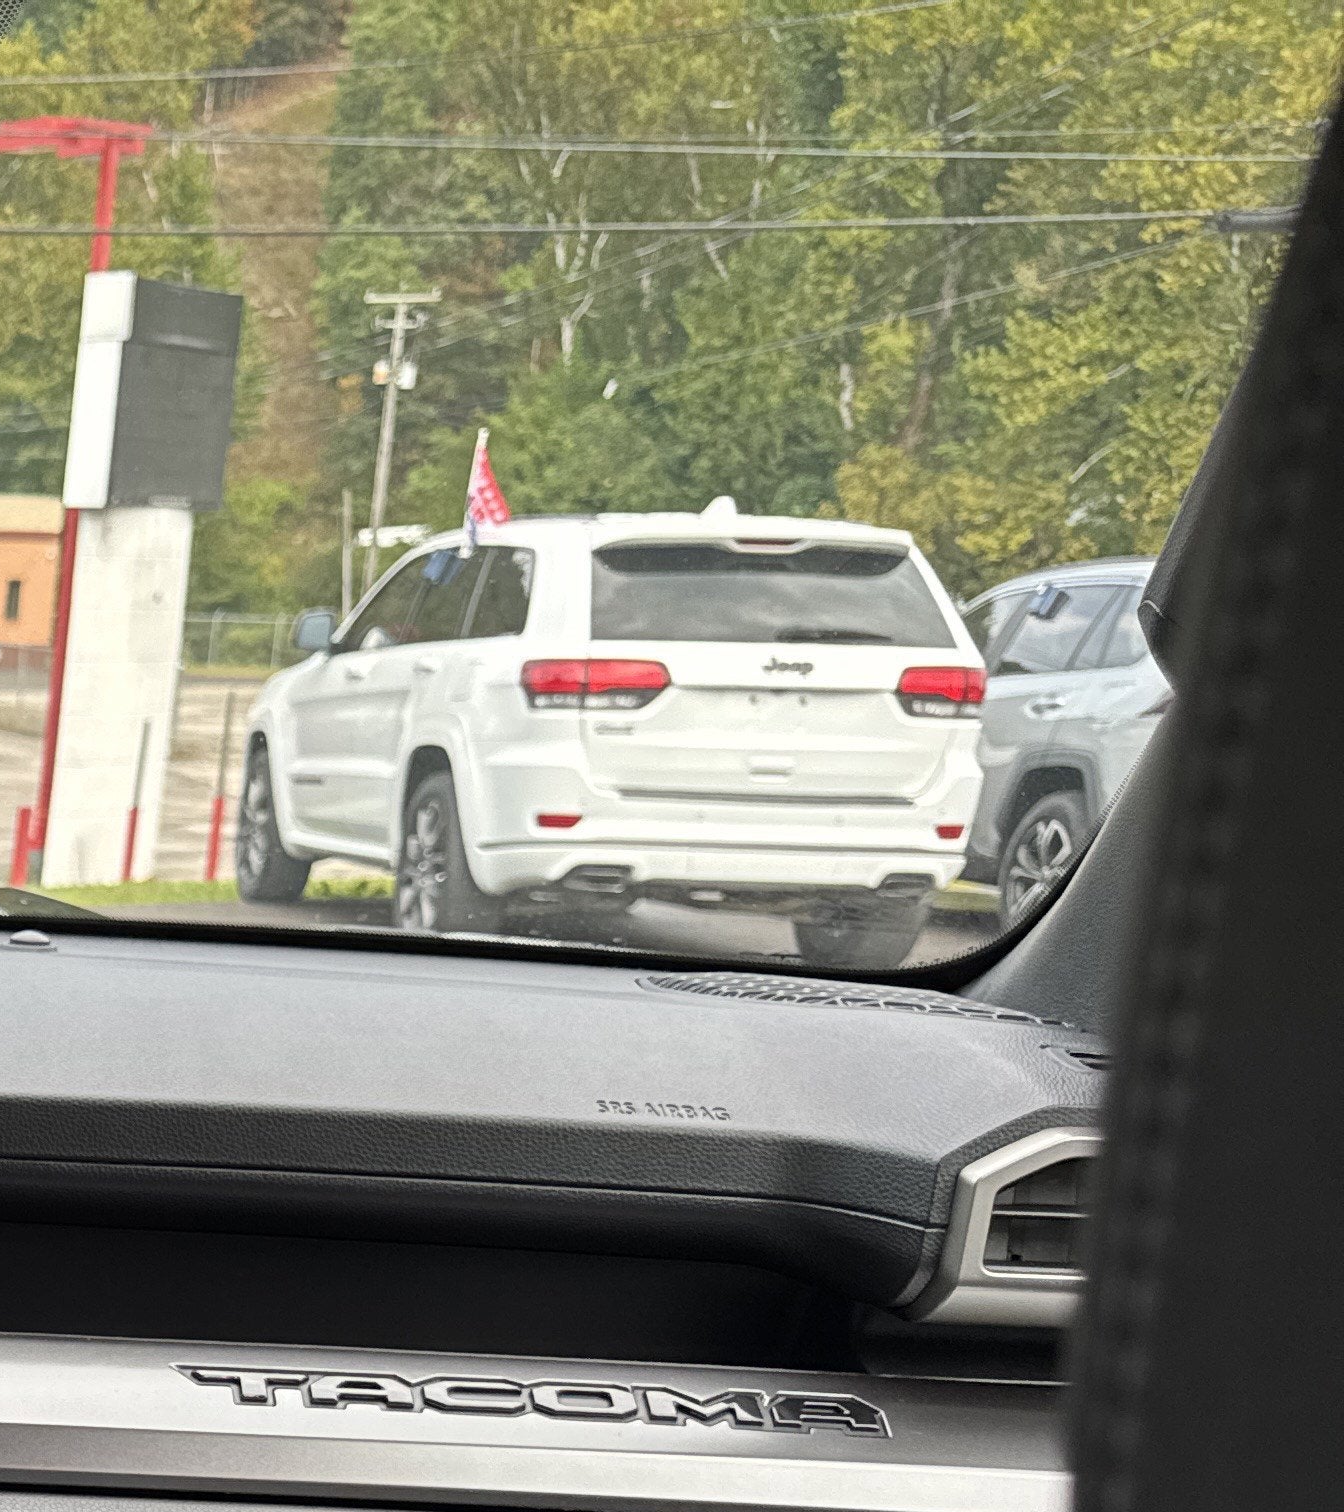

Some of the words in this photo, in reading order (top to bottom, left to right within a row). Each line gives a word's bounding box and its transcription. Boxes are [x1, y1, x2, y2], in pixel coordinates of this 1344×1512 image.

[596, 1098, 636, 1116] SRS
[643, 1101, 732, 1122] AIRBAG
[169, 1362, 893, 1439] TACOMA
